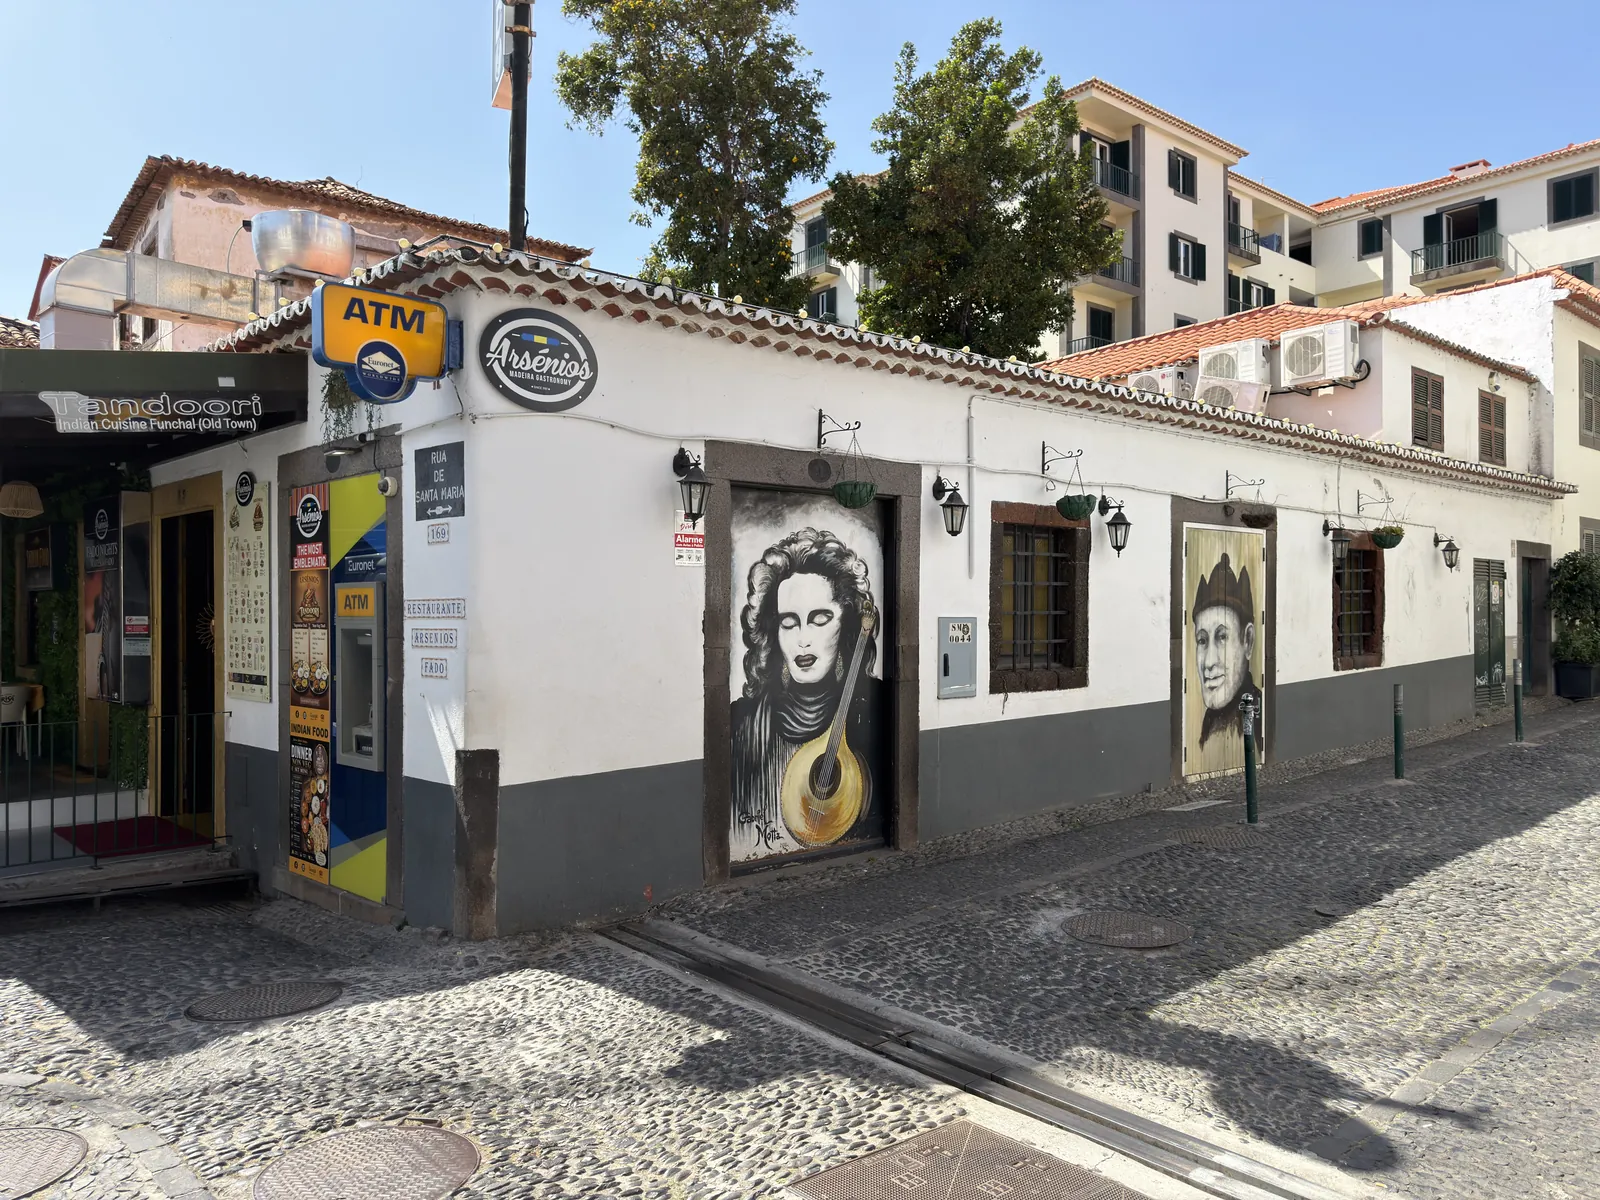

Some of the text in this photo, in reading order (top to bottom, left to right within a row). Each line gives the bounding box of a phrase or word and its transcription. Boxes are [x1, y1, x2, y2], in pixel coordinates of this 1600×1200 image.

[342, 297, 425, 334] ATM
[367, 356, 394, 369] Euronet
[485, 337, 593, 380] Arsénios
[362, 372, 401, 382] WORLDWIDE
[509, 370, 571, 386] MADEIRA GASTRONOMY
[40, 391, 263, 418] Tandoori
[58, 417, 257, 432] Indian Cuisine Funchal (Old Town)
[431, 450, 447, 464] RUA
[433, 469, 445, 483] DE
[416, 486, 465, 503] SANTA MARIA
[430, 526, 446, 540] 169
[676, 534, 703, 544] Alarme
[297, 543, 323, 556] THE MOST
[293, 556, 327, 569] EMBLEMATIC
[348, 559, 375, 572] Euronet
[343, 594, 369, 610] ATM
[407, 602, 462, 615] RESTAURANTE
[414, 632, 454, 644] ARSENIOS
[949, 635, 972, 643] 0044
[424, 661, 445, 674] FADO
[291, 722, 329, 739] INDIAN FOOD
[291, 744, 313, 761] DINNER
